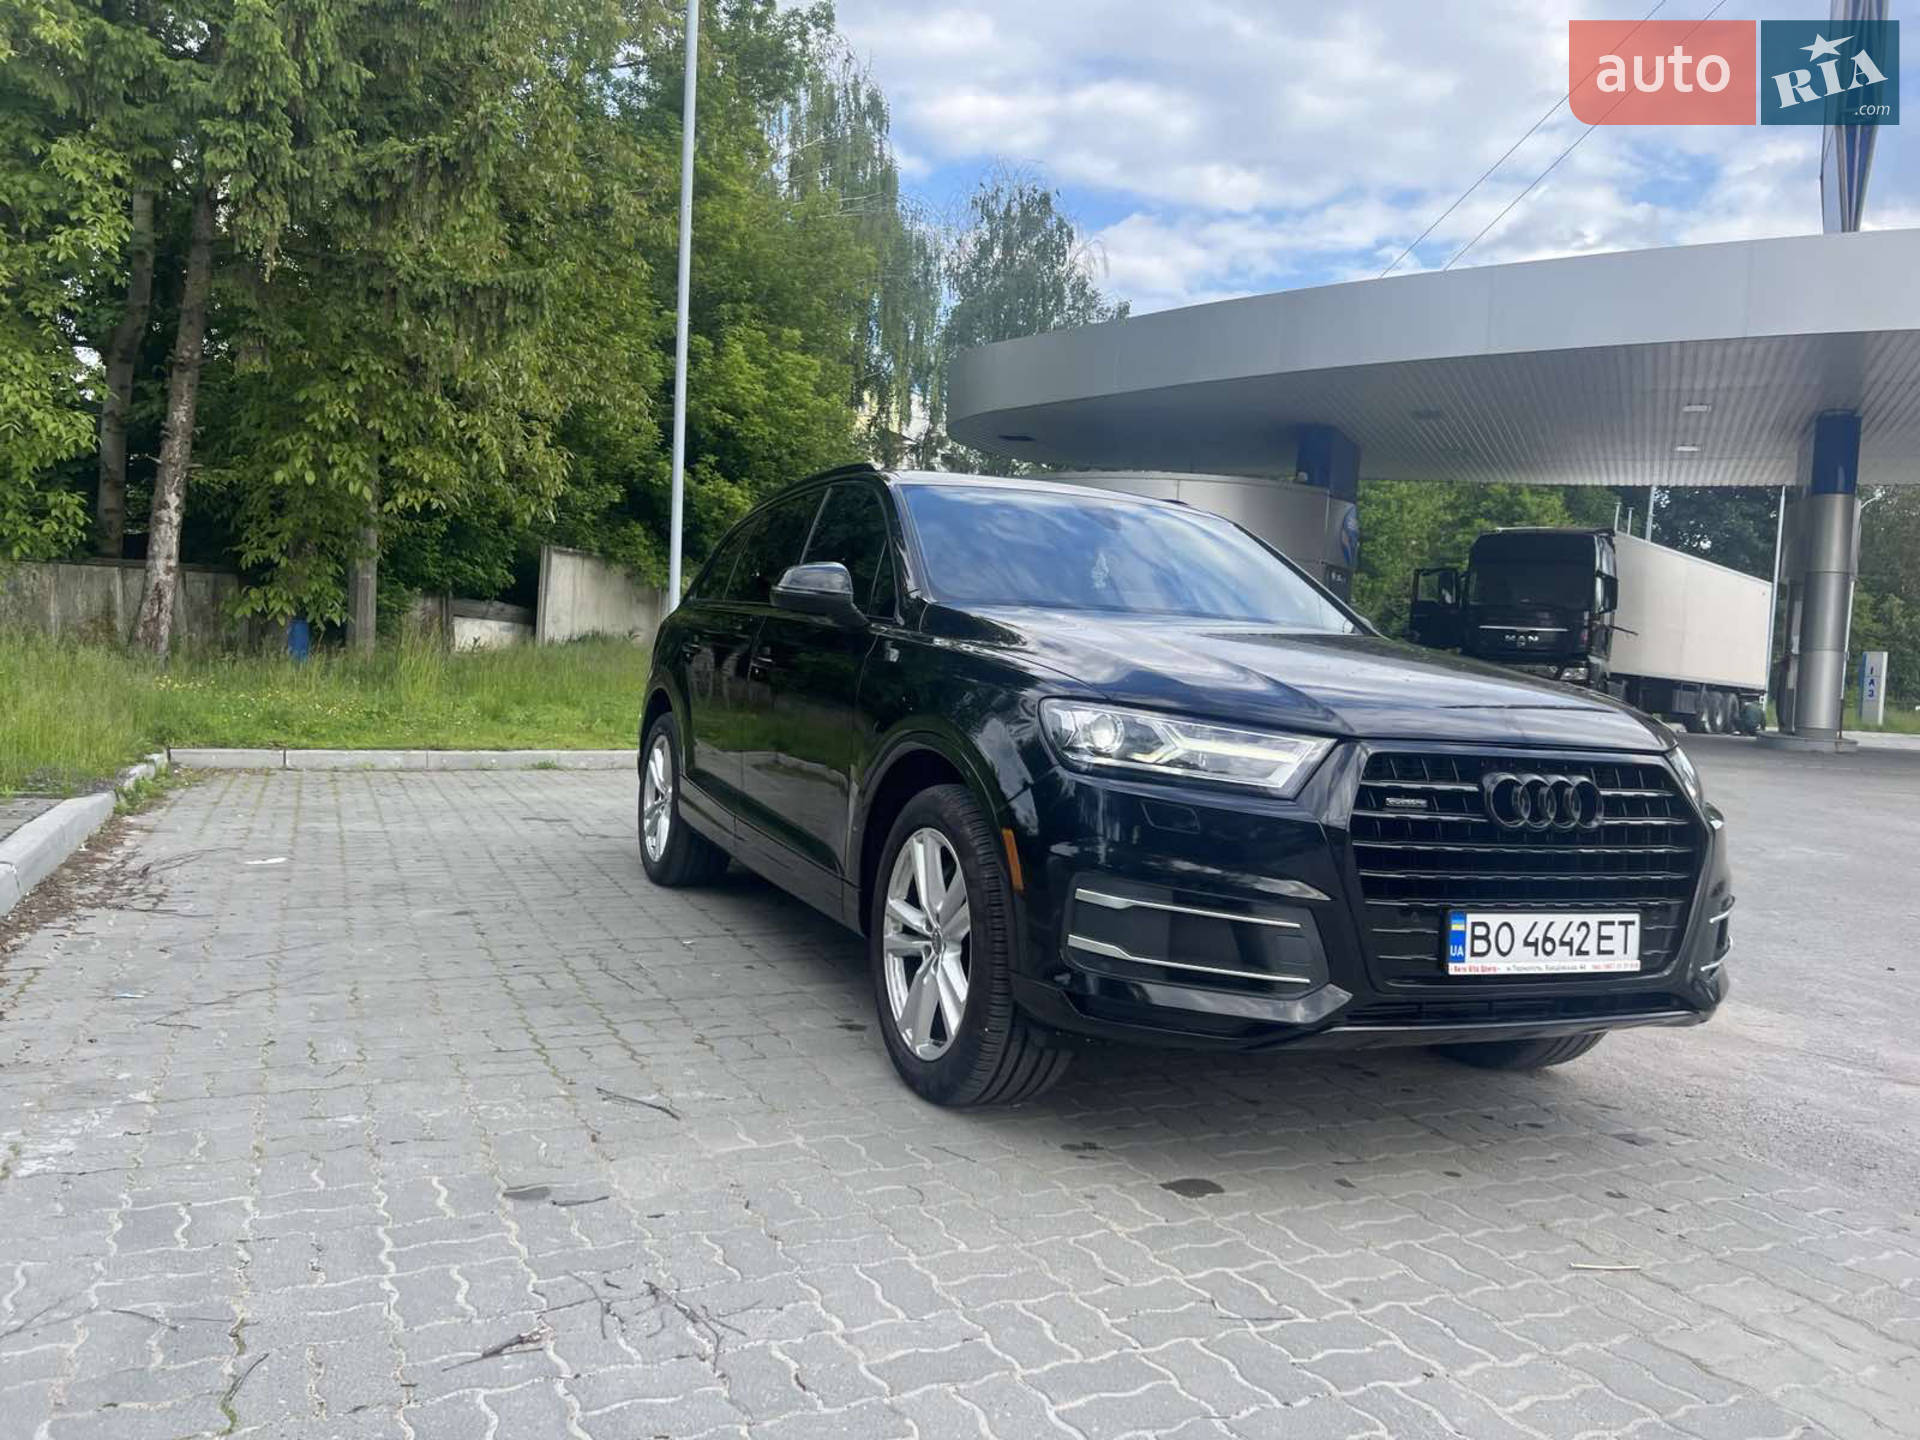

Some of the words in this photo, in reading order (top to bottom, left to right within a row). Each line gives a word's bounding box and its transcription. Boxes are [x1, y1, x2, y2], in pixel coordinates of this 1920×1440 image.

[1505, 634, 1539, 642] MAN
[1469, 921, 1516, 957] BO
[1522, 920, 1591, 957] 4642
[1596, 920, 1637, 955] ET
[1450, 944, 1464, 957] UA
